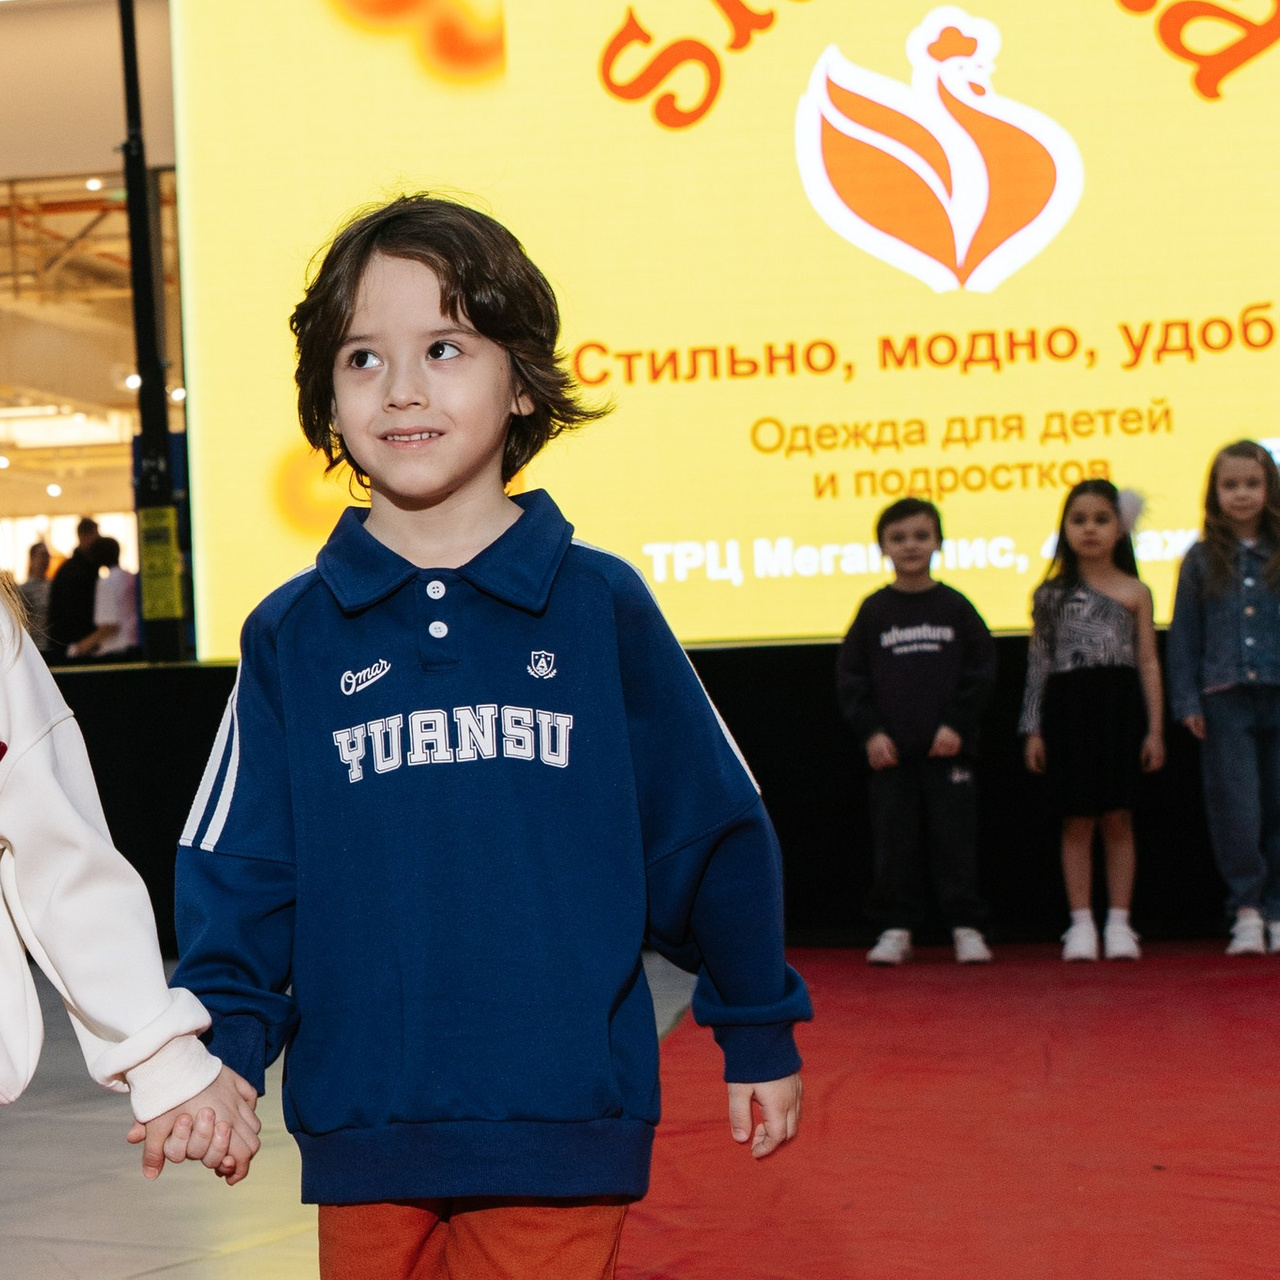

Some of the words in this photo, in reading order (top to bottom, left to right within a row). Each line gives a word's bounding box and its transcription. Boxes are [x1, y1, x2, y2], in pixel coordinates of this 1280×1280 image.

[573, 338, 854, 387] Стильно,
[878, 323, 1097, 374] модно,
[749, 414, 927, 457] Одежда
[940, 415, 1023, 446] для
[1039, 397, 1174, 441] детей
[813, 470, 839, 500] и
[853, 457, 1112, 501] подростков
[642, 538, 744, 588] ТРЦ
[753, 534, 1030, 579] Мегаплис,
[340, 658, 391, 696] Omar
[332, 703, 573, 783] YUANSU
